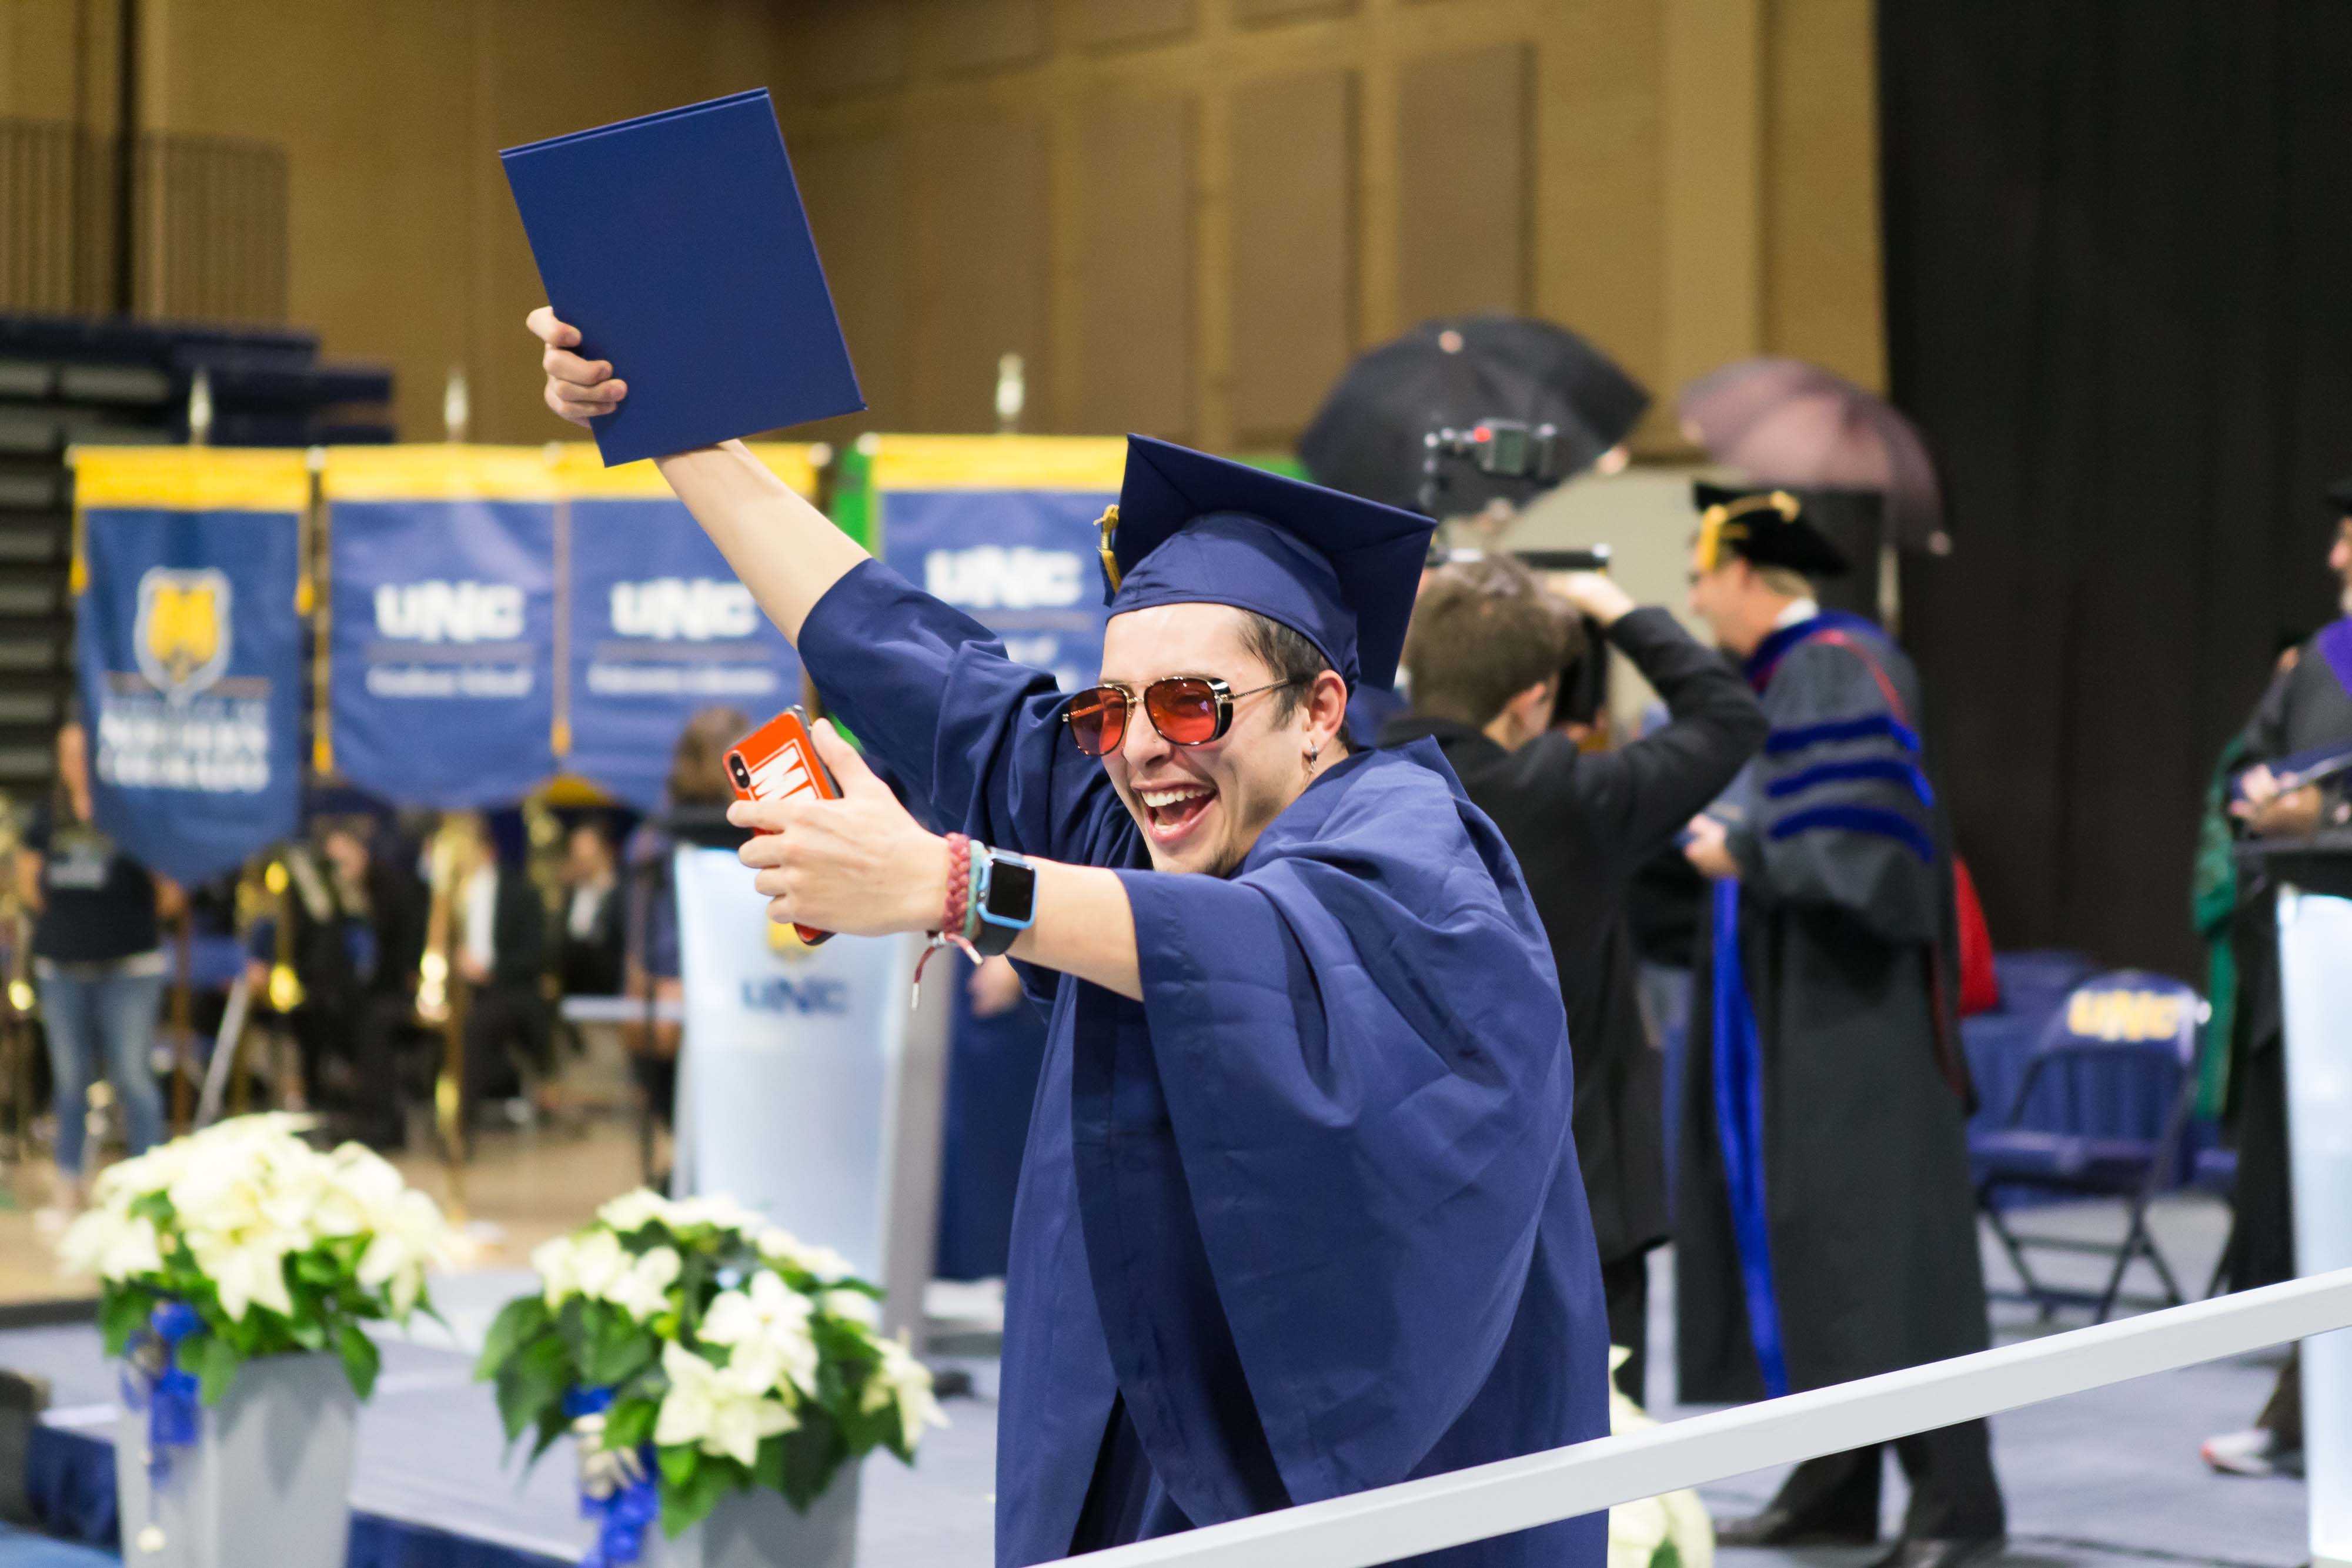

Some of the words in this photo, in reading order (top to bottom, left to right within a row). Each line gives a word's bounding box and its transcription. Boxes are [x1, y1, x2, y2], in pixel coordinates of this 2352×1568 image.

[926, 546, 1081, 608] UNC
[375, 581, 524, 642] UNC
[611, 579, 759, 640] UNC
[741, 977, 848, 1015] UNC
